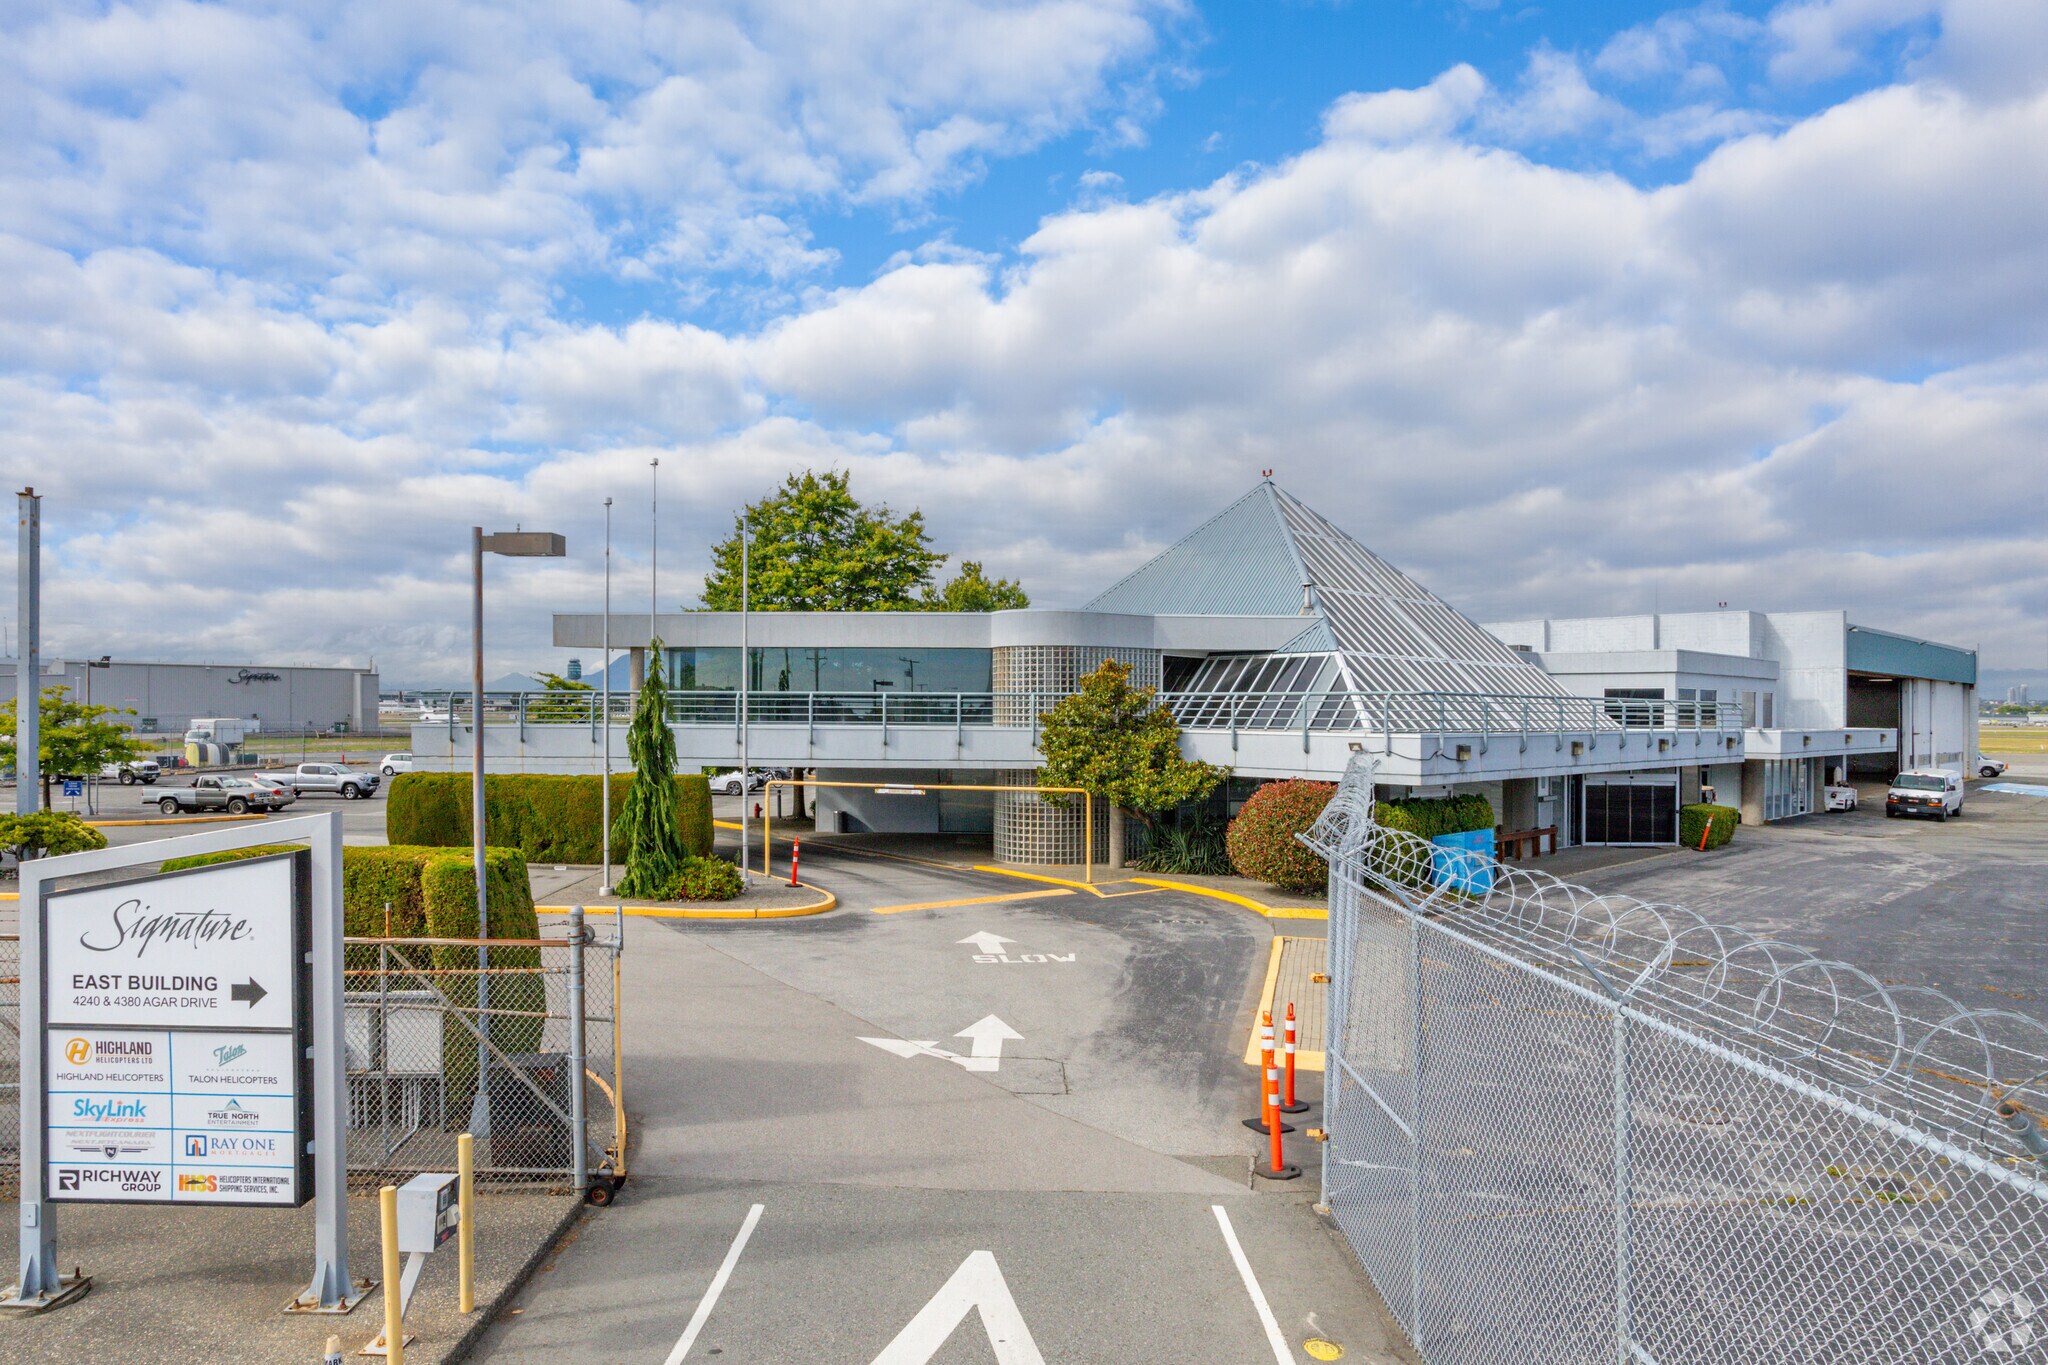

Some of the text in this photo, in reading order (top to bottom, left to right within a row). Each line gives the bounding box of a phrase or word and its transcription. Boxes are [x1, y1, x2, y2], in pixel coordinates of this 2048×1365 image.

[80, 899, 252, 958] Signature
[971, 953, 1076, 964] SLOW
[73, 975, 218, 991] EAST BUILDING
[73, 996, 217, 1008] 4240 & 4380 AGAR DRIVE
[95, 1041, 152, 1055] HIGHLAND
[213, 1044, 247, 1067] Talon
[56, 1073, 164, 1082] HIGHLAND HELICOPTERS
[188, 1075, 278, 1085] TALON HELICOPTERS
[73, 1098, 147, 1122] SkyLink
[207, 1112, 260, 1121] TRUE NORTH
[211, 1137, 276, 1151] RAY ONE
[82, 1169, 162, 1183] RICHWAY
[219, 1175, 290, 1185] HELICOPTERS INTERNATIONAL
[121, 1183, 162, 1192] GROUP
[219, 1185, 280, 1194] SHIPPING SERVICES, INC.
